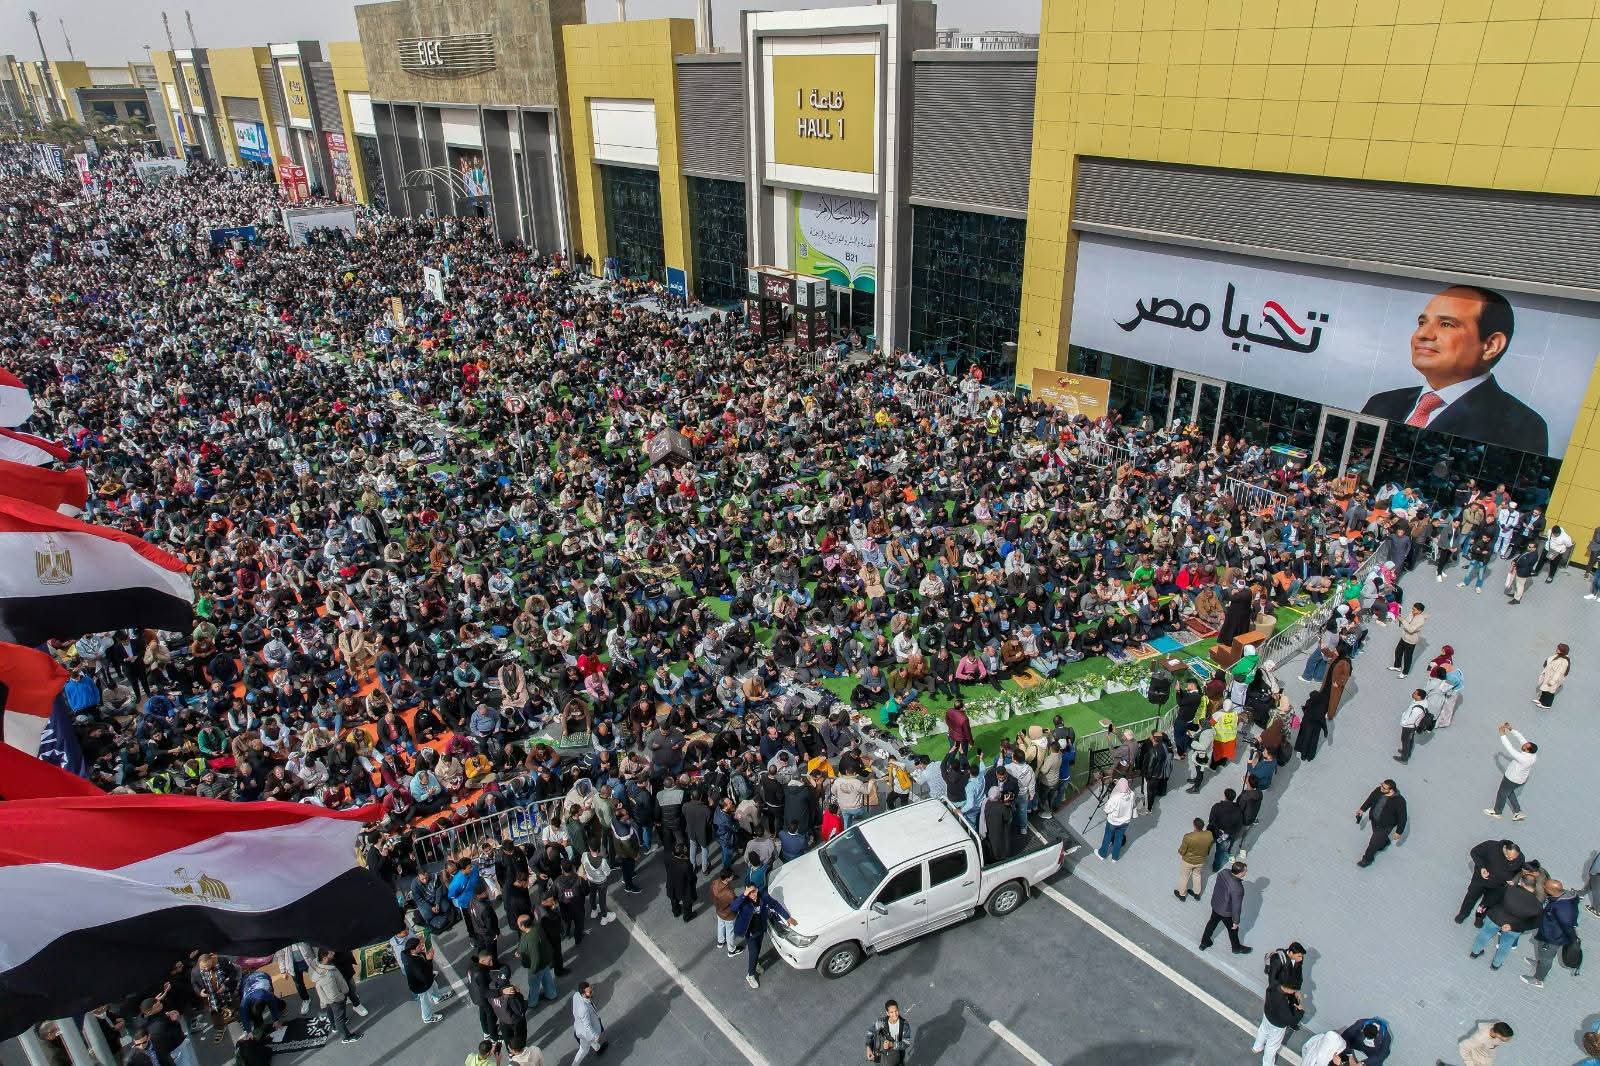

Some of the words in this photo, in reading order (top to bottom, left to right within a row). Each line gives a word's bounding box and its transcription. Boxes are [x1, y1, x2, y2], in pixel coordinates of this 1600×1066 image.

[417, 40, 443, 65] EIEC
[810, 89, 844, 111] قاعة
[798, 118, 833, 139] HALL
[838, 119, 845, 140] 1
[845, 252, 858, 263] B21
[1112, 297, 1211, 332] مصر
[1221, 281, 1329, 353] تحيا
